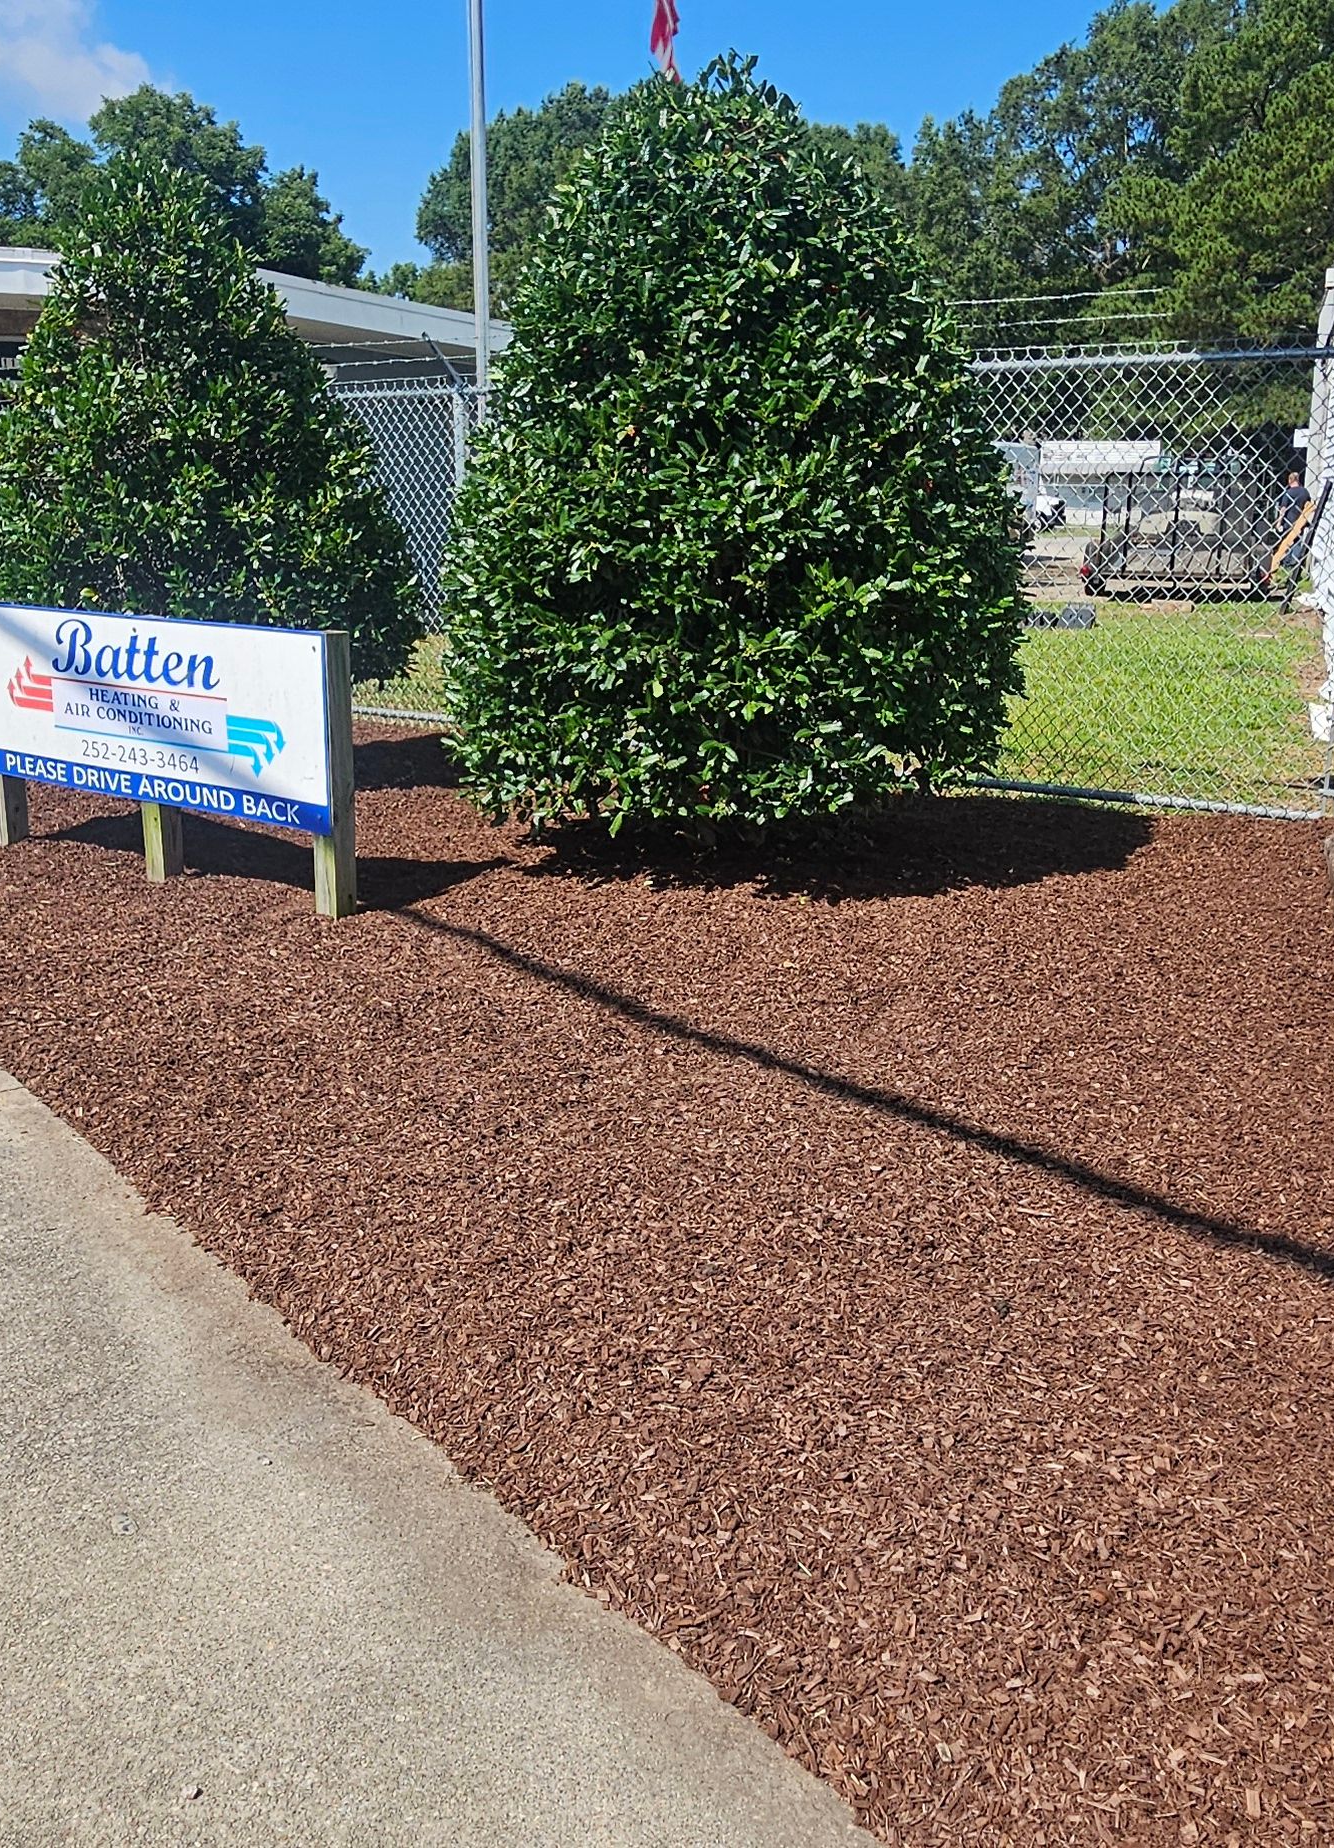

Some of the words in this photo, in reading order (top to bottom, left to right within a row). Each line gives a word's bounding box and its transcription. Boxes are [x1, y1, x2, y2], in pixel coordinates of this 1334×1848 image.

[52, 619, 220, 691] Batten
[89, 687, 160, 710] HEATING
[169, 699, 181, 713] &
[64, 702, 91, 718] AIR
[96, 706, 213, 735] CONDITIONING
[81, 739, 200, 775] 252-243-3464
[5, 753, 68, 783] PLEASE
[72, 768, 133, 795] DRIVE
[137, 777, 235, 812] AROUND
[242, 794, 301, 826] BACK
